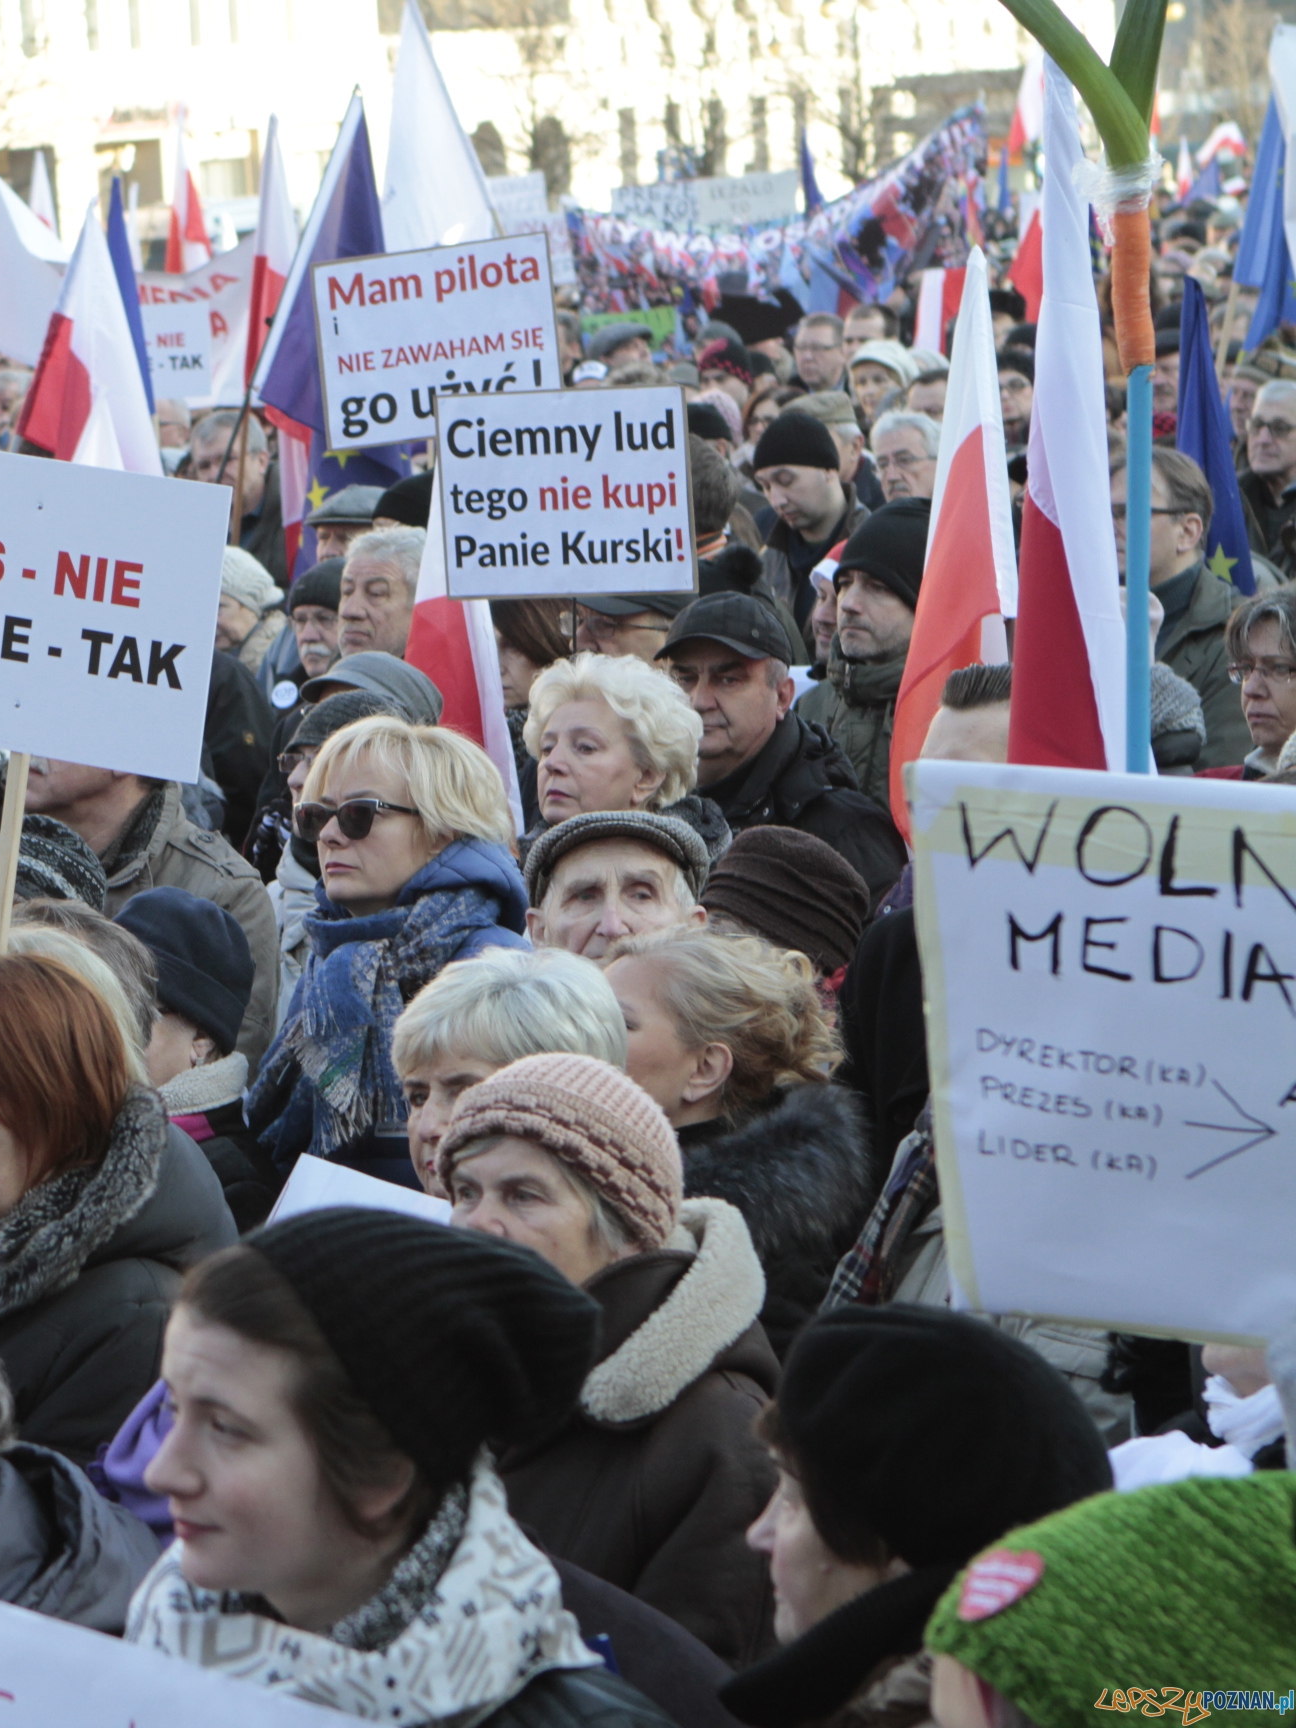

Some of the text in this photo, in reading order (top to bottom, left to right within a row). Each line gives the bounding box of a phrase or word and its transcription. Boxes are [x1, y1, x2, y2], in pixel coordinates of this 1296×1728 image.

[327, 253, 540, 311] Mam pilota
[157, 332, 185, 348] NIE
[332, 316, 339, 336] i
[168, 354, 203, 371] TAK
[337, 327, 545, 375] NIE ZAWAHAM SIĘ
[341, 392, 398, 438] go
[447, 408, 675, 462] Ciemny lud
[450, 471, 677, 520] tego nie kupi
[454, 527, 685, 568] Panie Kurski!
[22, 568, 36, 580] -
[53, 550, 144, 608] NIE
[47, 646, 62, 658] -
[81, 628, 187, 691] TAK
[1007, 910, 1296, 1019] MEDIA
